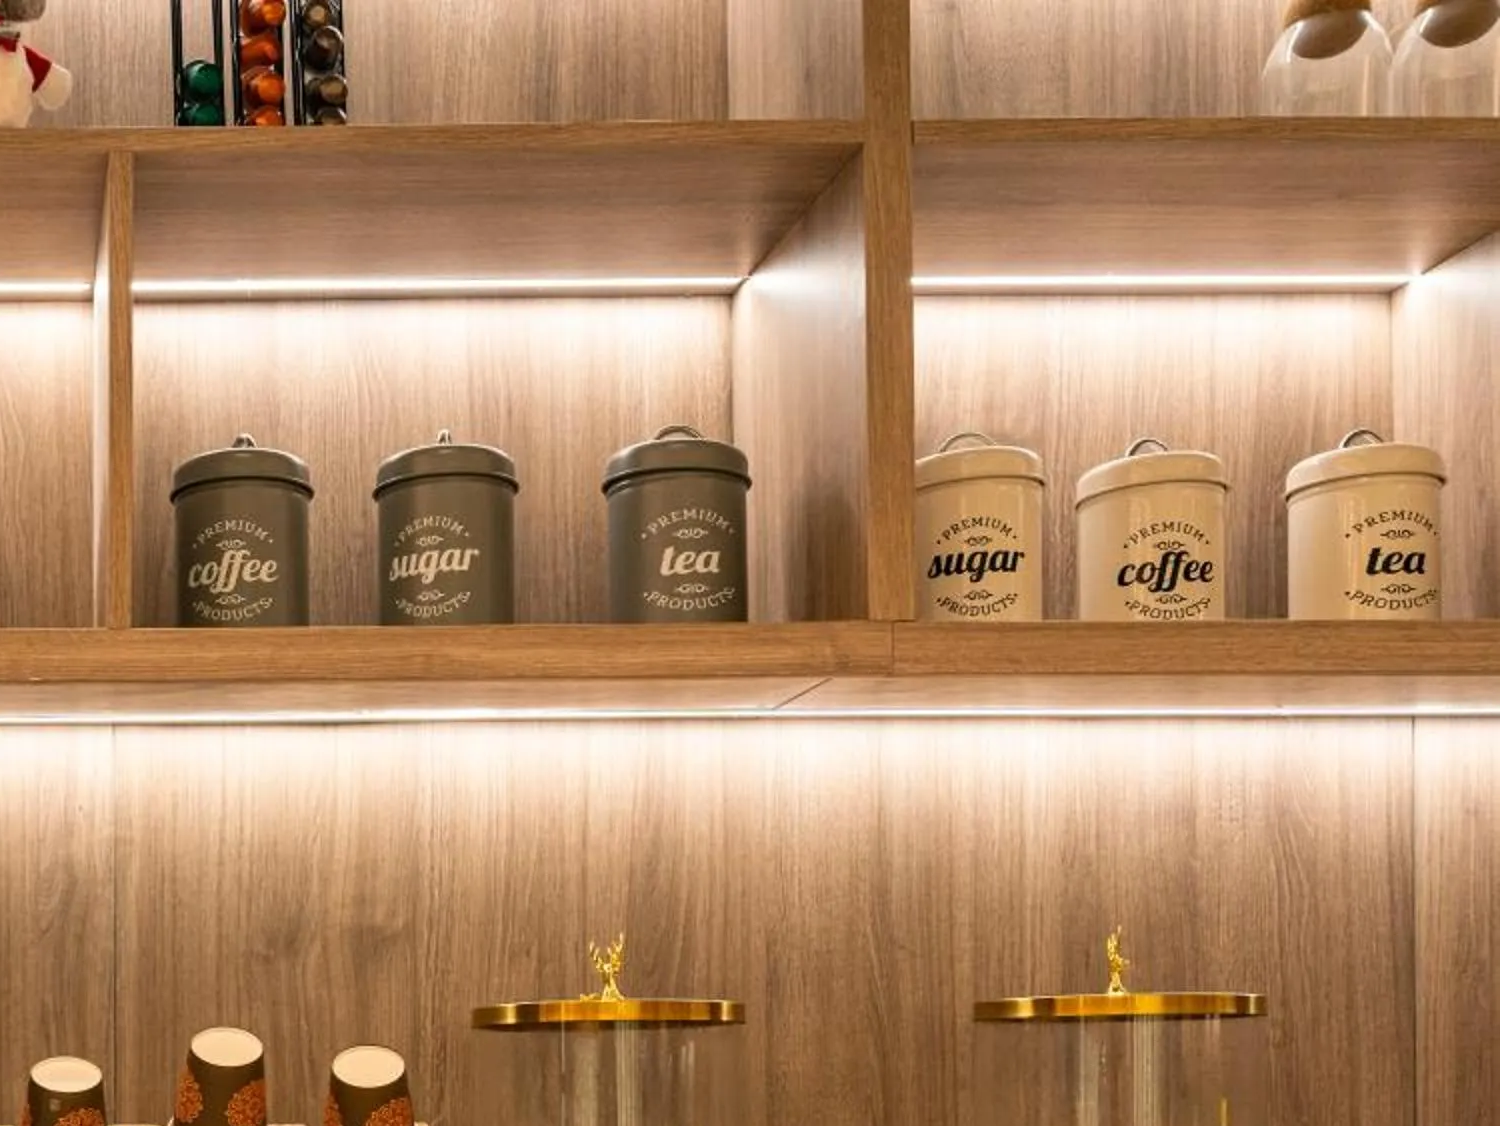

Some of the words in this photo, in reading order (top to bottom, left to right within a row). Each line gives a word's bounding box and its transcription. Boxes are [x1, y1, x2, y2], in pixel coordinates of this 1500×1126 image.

[197, 519, 270, 544] PREMIUM
[398, 515, 465, 542] PREMIUM
[648, 508, 730, 535] PREMIUM
[942, 516, 1013, 541] PREMIUM
[1130, 521, 1205, 545] PREMIUM
[1352, 510, 1434, 534] PREMIUM
[188, 549, 279, 594] coffee
[389, 548, 480, 585] sugar
[660, 546, 721, 576] tea
[927, 549, 1025, 583] sugar
[1117, 550, 1215, 593] coffee
[1365, 546, 1426, 576] tea
[195, 597, 271, 621] PRODUCTS
[397, 591, 470, 618] PRODUCTS
[646, 587, 735, 611] PRODUCTS
[940, 593, 1015, 617] PRODUCTS
[1129, 597, 1211, 621] PRODUCTS
[1350, 588, 1437, 611] PRODUCTS
